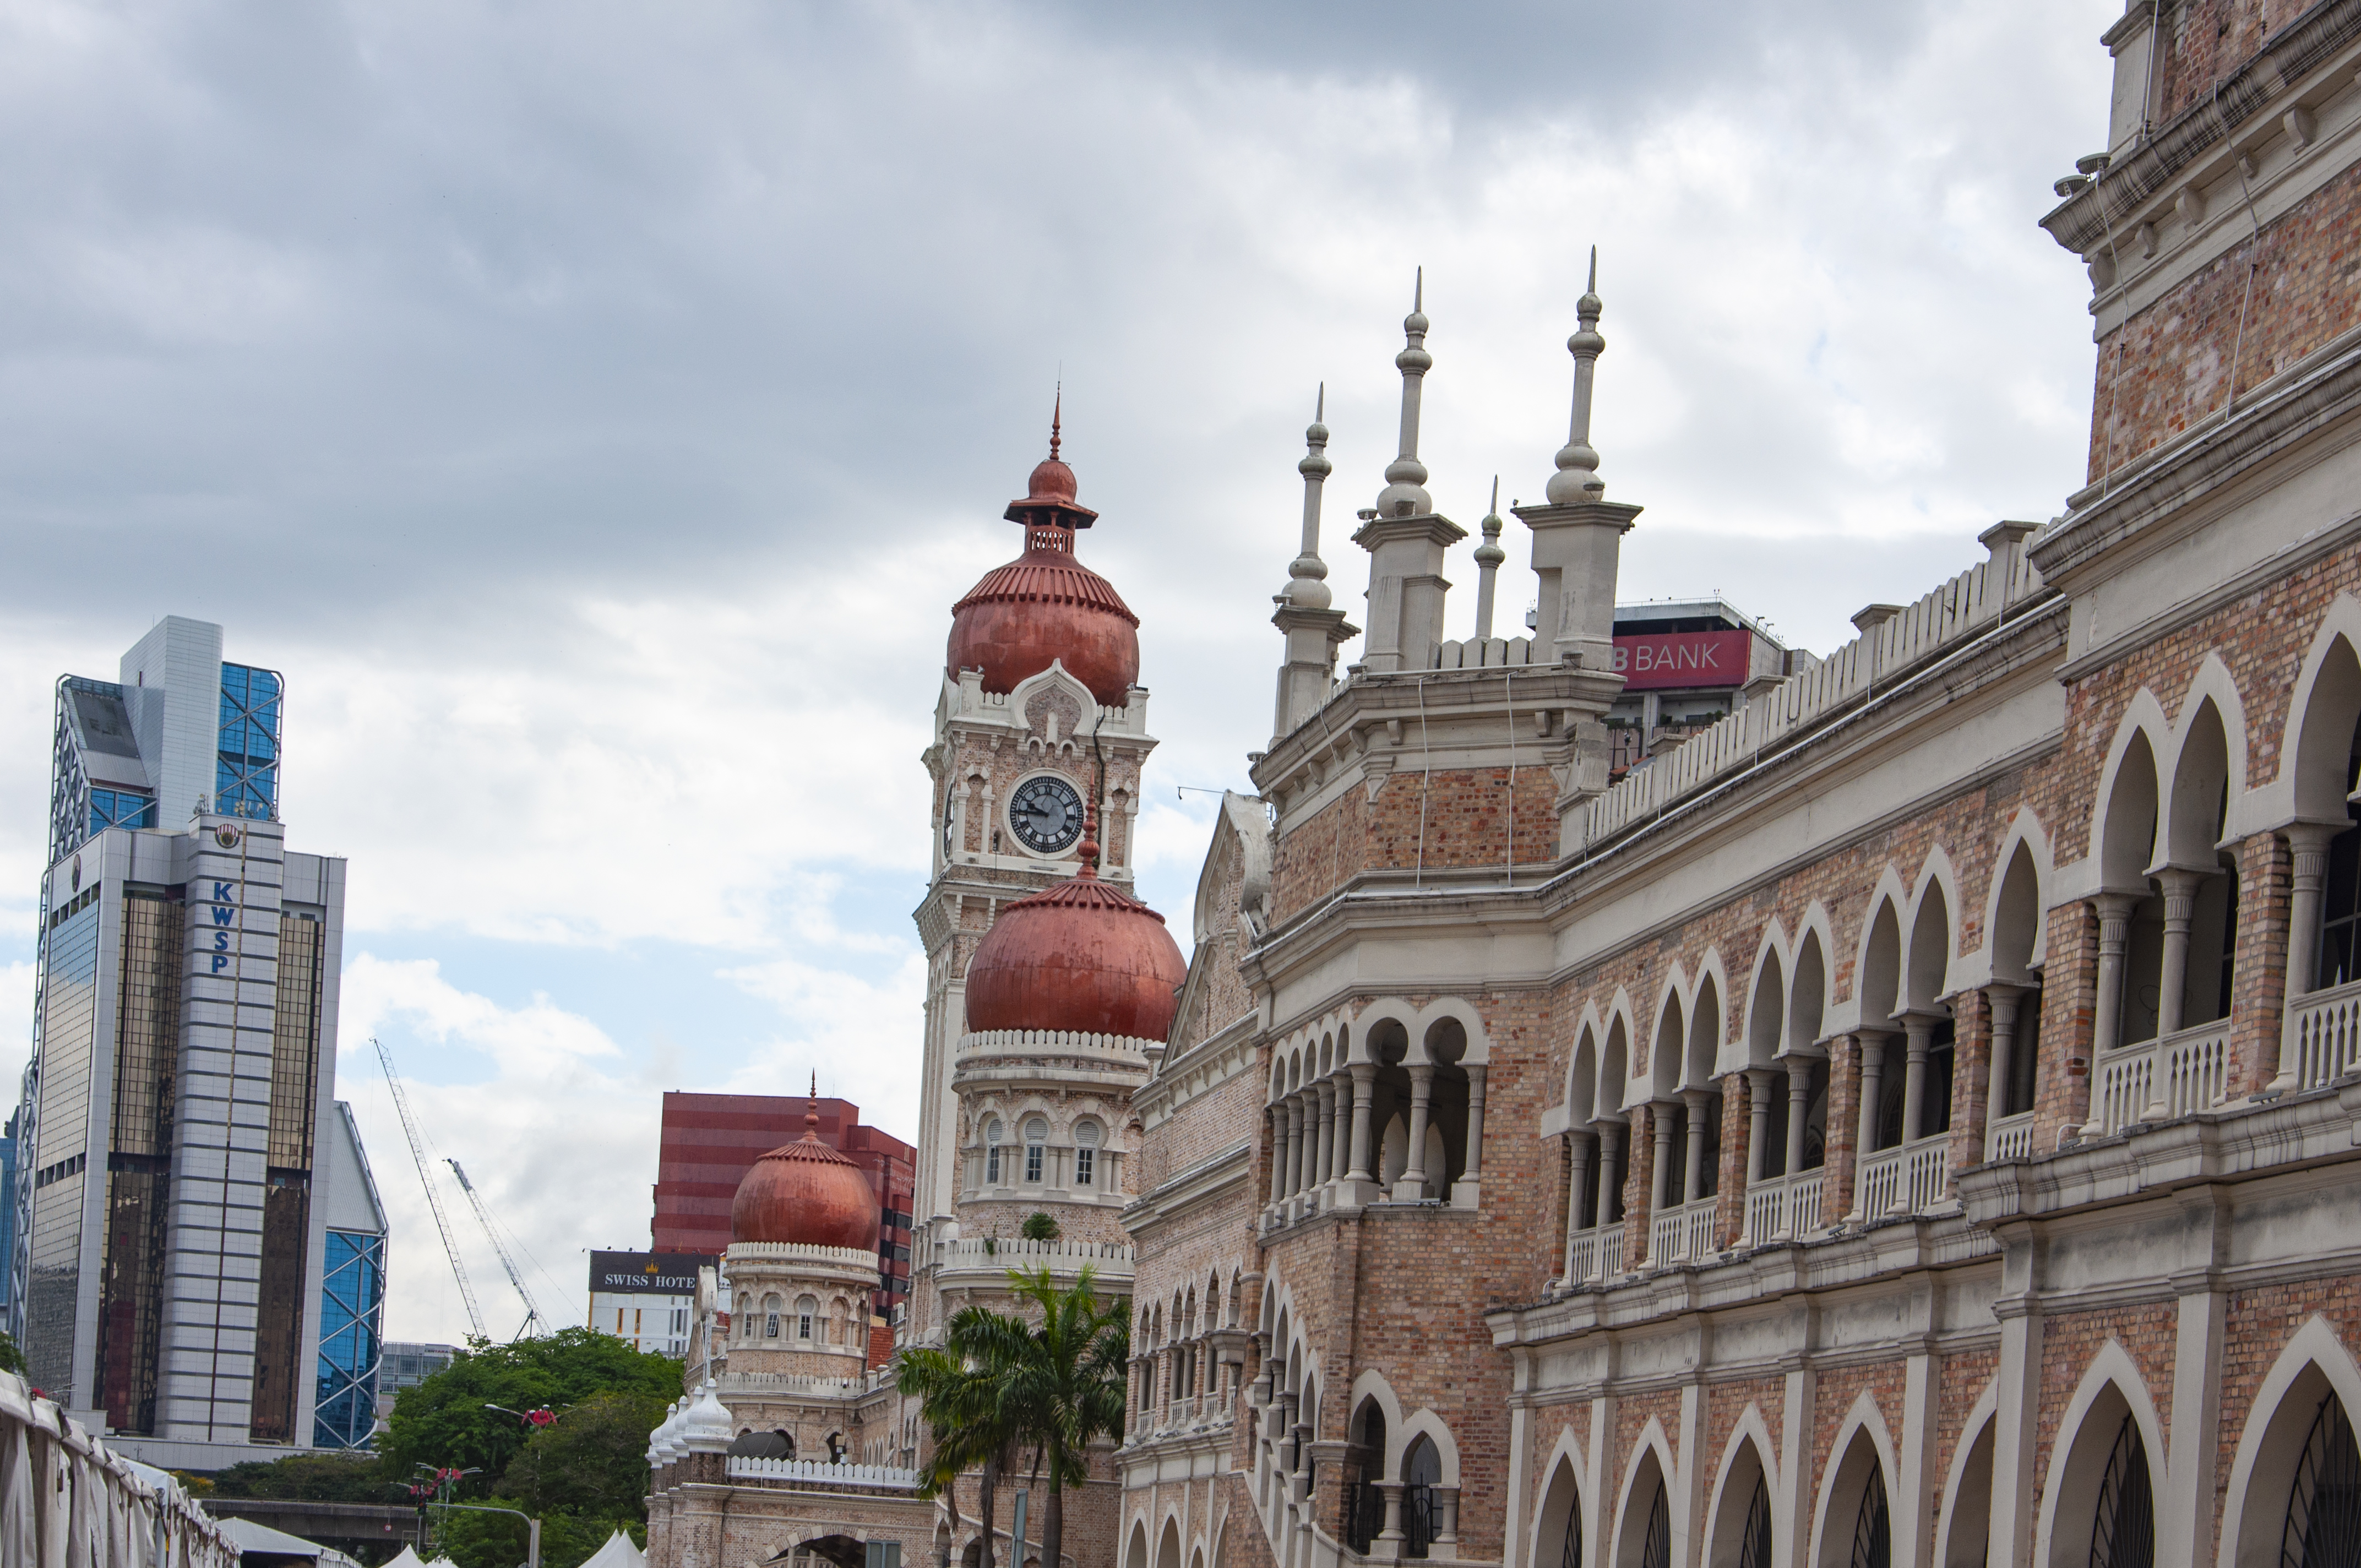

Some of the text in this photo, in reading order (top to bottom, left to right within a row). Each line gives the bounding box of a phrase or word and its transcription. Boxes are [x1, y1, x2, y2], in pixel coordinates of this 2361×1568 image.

[1635, 643, 1720, 671] BANK
[211, 882, 235, 973] KWSP
[605, 1274, 698, 1288] SWISS HOTE
